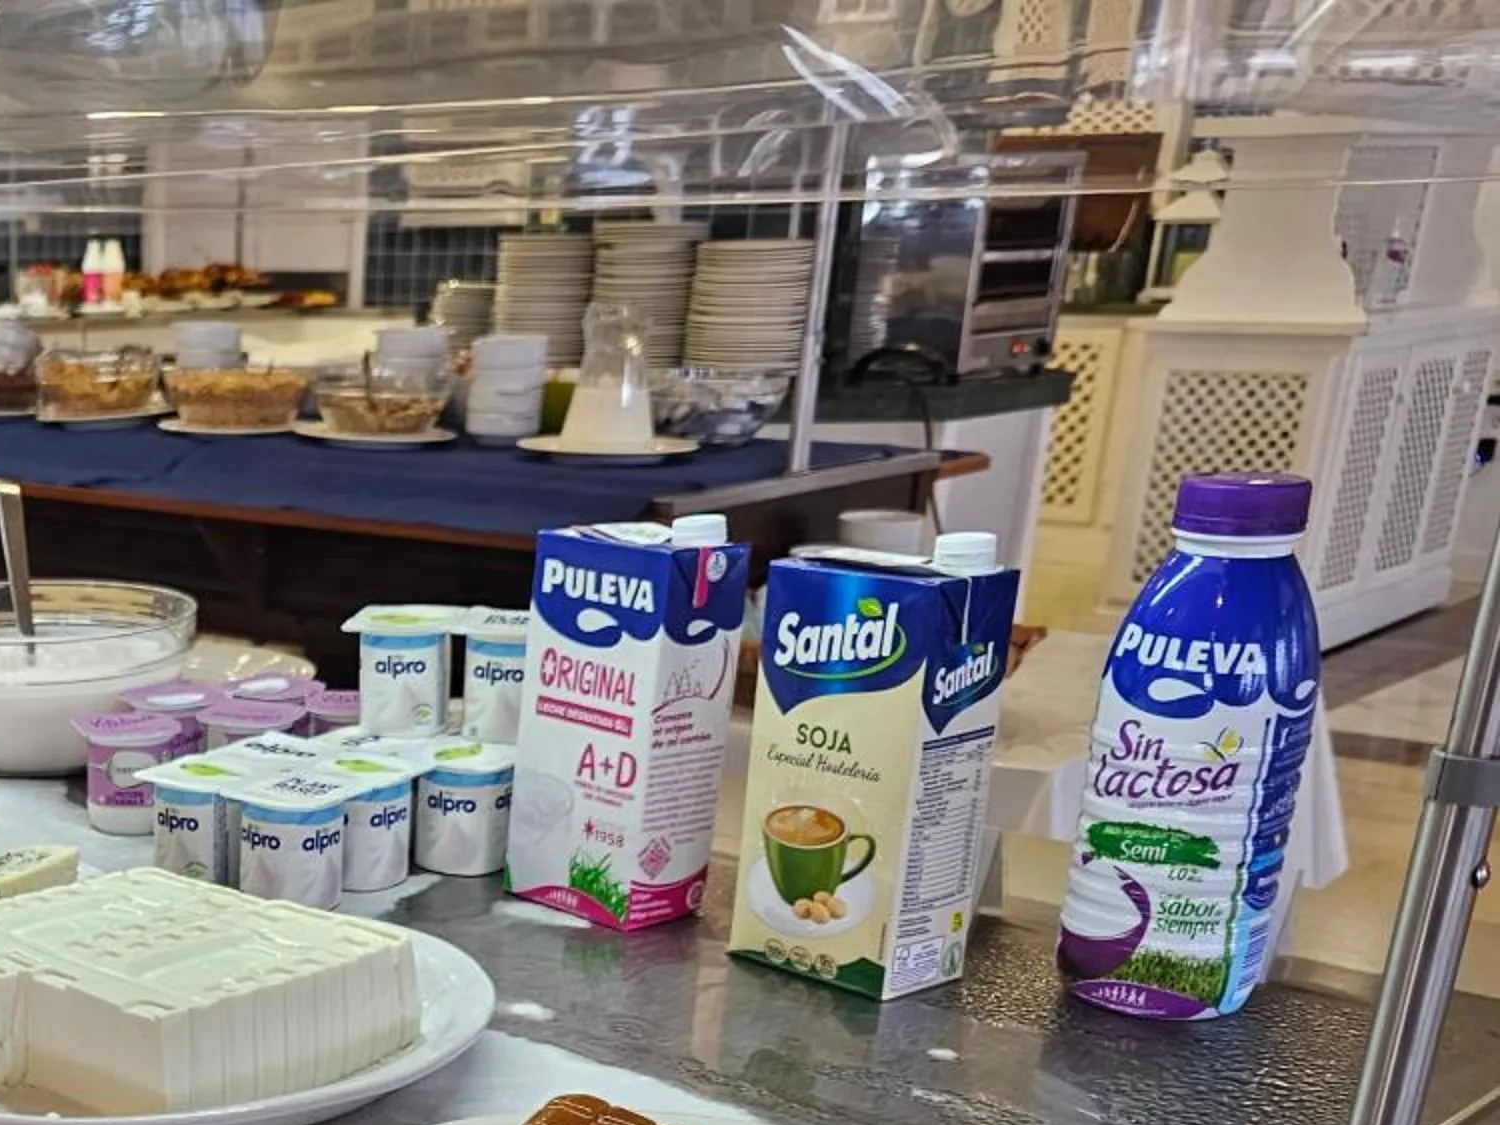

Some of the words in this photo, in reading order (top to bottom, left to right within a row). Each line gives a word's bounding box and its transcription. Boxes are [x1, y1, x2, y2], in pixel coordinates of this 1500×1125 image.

[541, 558, 654, 613] PULEVA
[774, 602, 899, 667] Santal
[1114, 622, 1268, 676] PULEVA
[375, 655, 426, 680] alpro
[474, 661, 525, 686] alpro
[539, 648, 636, 706] ORIGINAL
[932, 640, 995, 705] Santal
[796, 723, 852, 755] SOJA
[1110, 719, 1164, 761] Sin
[576, 742, 638, 789] A+D
[767, 743, 815, 769] Especial
[427, 790, 477, 816] alpro
[157, 808, 199, 833] alpro
[595, 829, 626, 848] 1958
[1120, 840, 1169, 862] Semi
[1157, 898, 1217, 917] sabor
[1154, 916, 1220, 940] siempre
